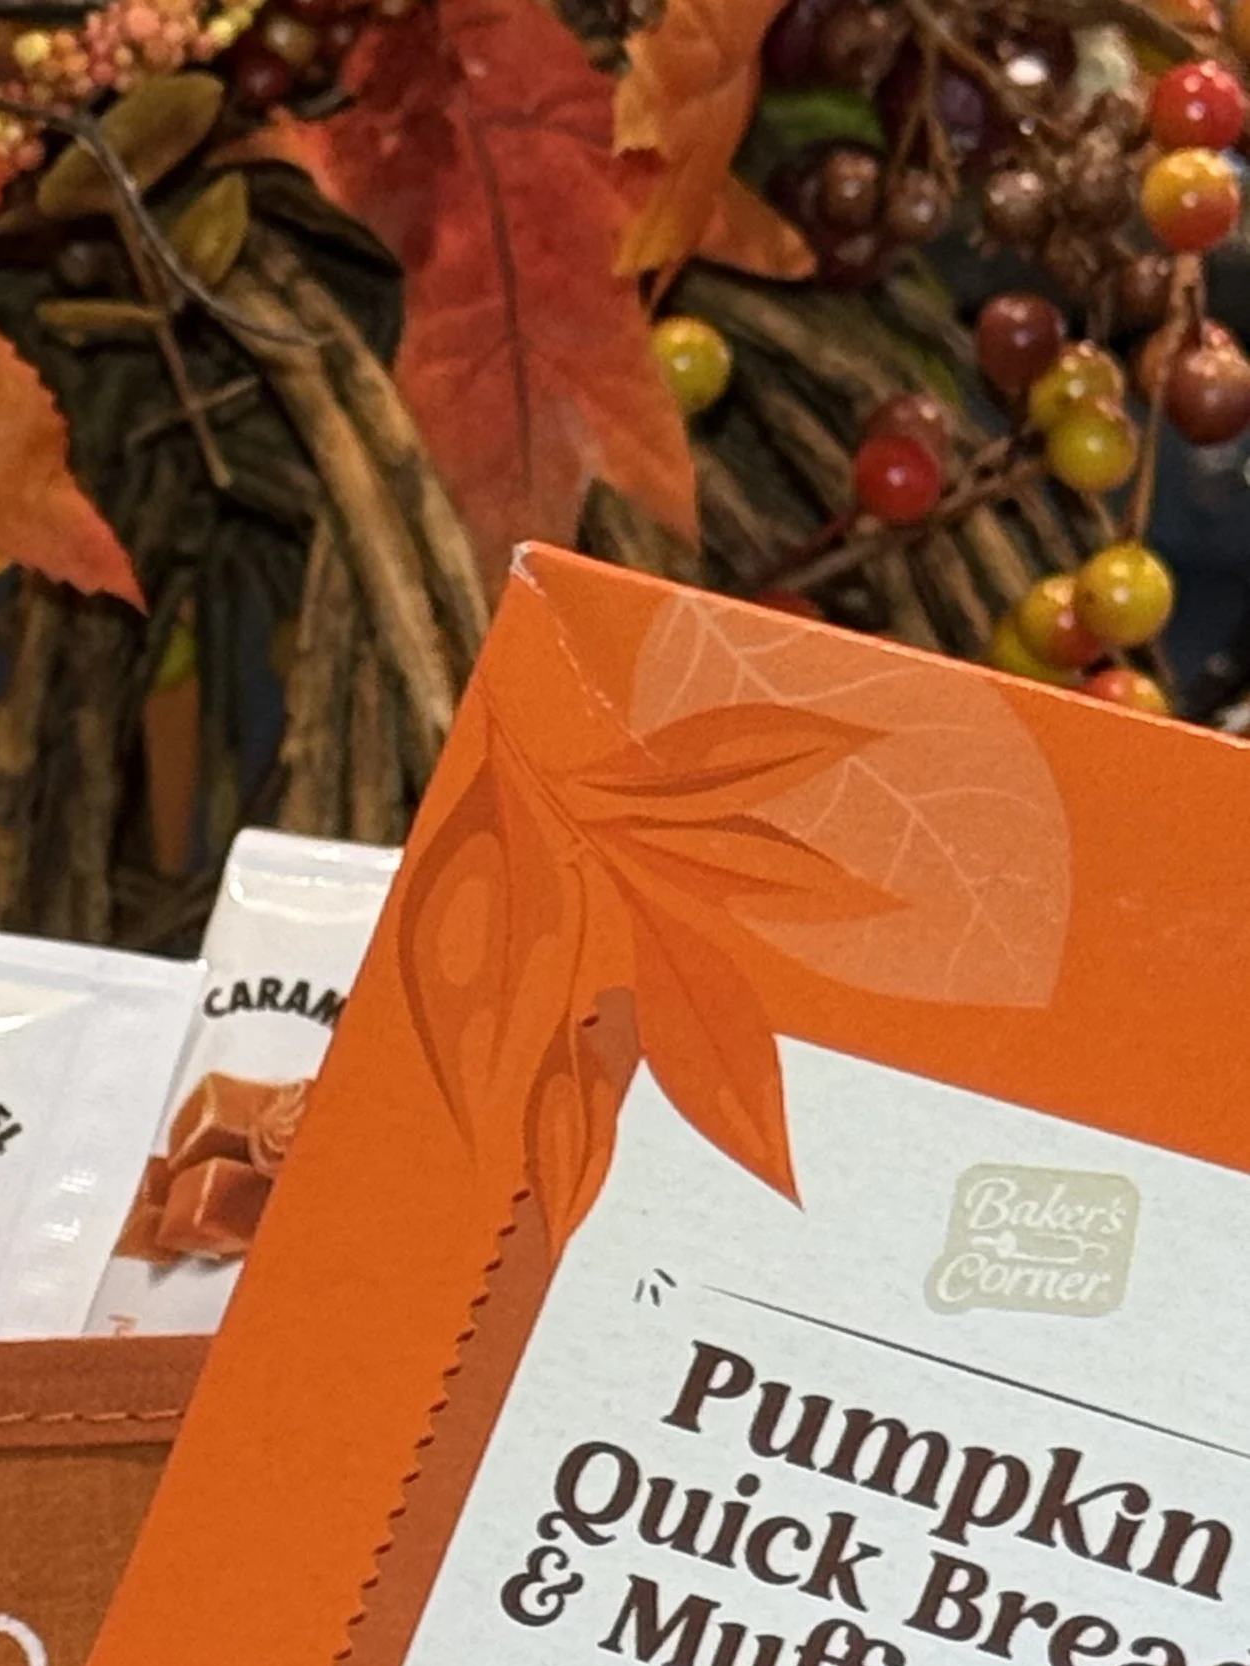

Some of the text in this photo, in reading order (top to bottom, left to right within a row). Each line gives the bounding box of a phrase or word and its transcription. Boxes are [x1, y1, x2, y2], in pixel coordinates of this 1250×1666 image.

[203, 976, 348, 1030] CARAM
[964, 1176, 1127, 1235] Baker's
[936, 1252, 1111, 1304] Corner
[661, 1340, 1234, 1602] Pumpkin
[536, 1441, 883, 1613] Quick
[500, 1545, 584, 1628] &
